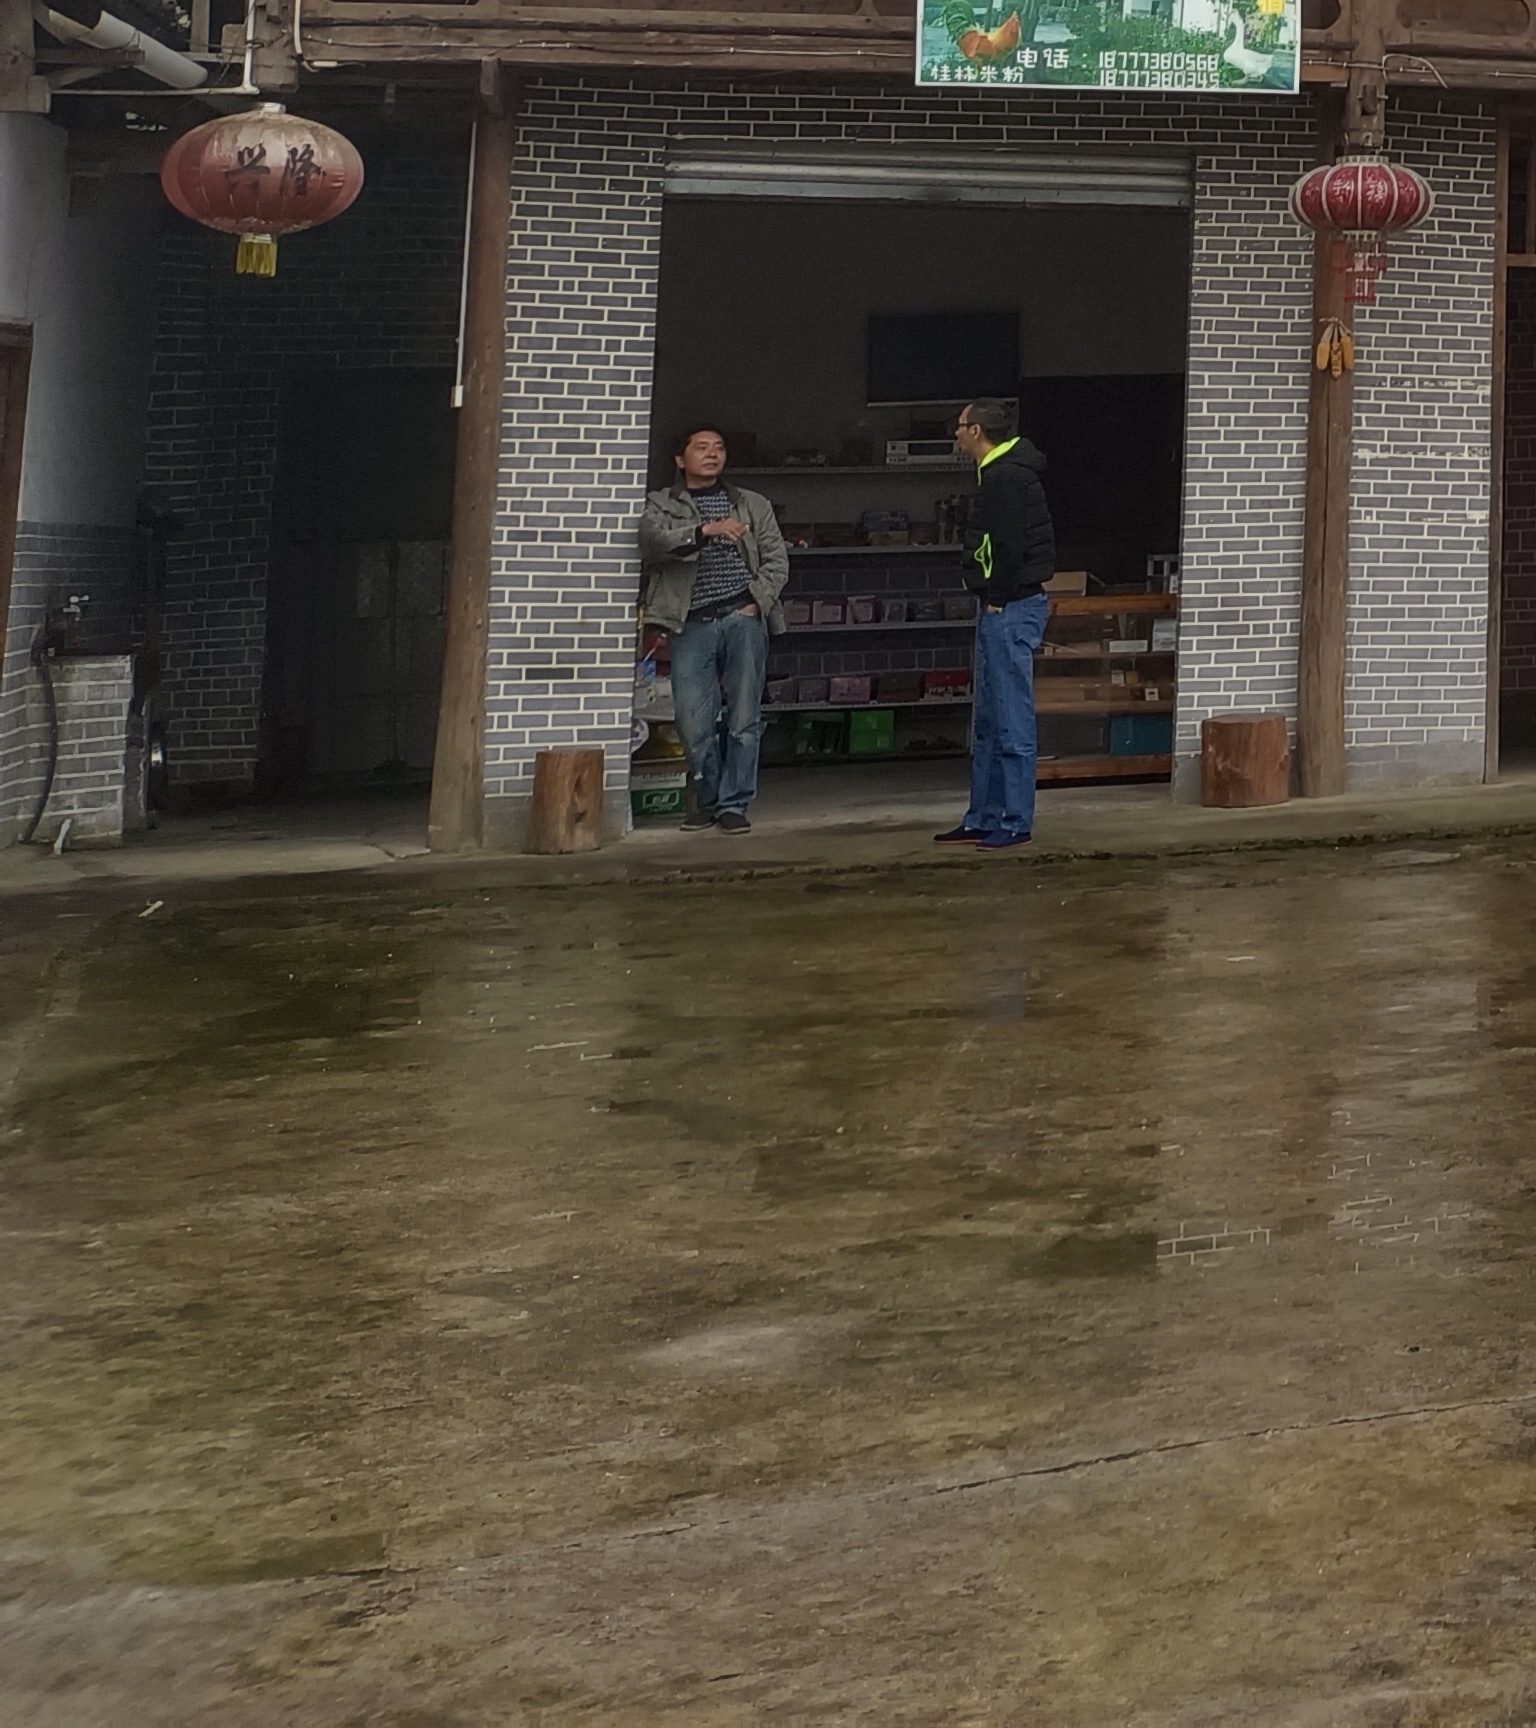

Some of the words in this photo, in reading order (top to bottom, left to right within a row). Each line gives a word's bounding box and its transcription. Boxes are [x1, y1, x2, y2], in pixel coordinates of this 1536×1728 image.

[1099, 50, 1220, 71] 18777380568
[931, 64, 1025, 83] 桂林米粉
[1099, 69, 1220, 89] 18777380345
[225, 143, 328, 197] 兴隆
